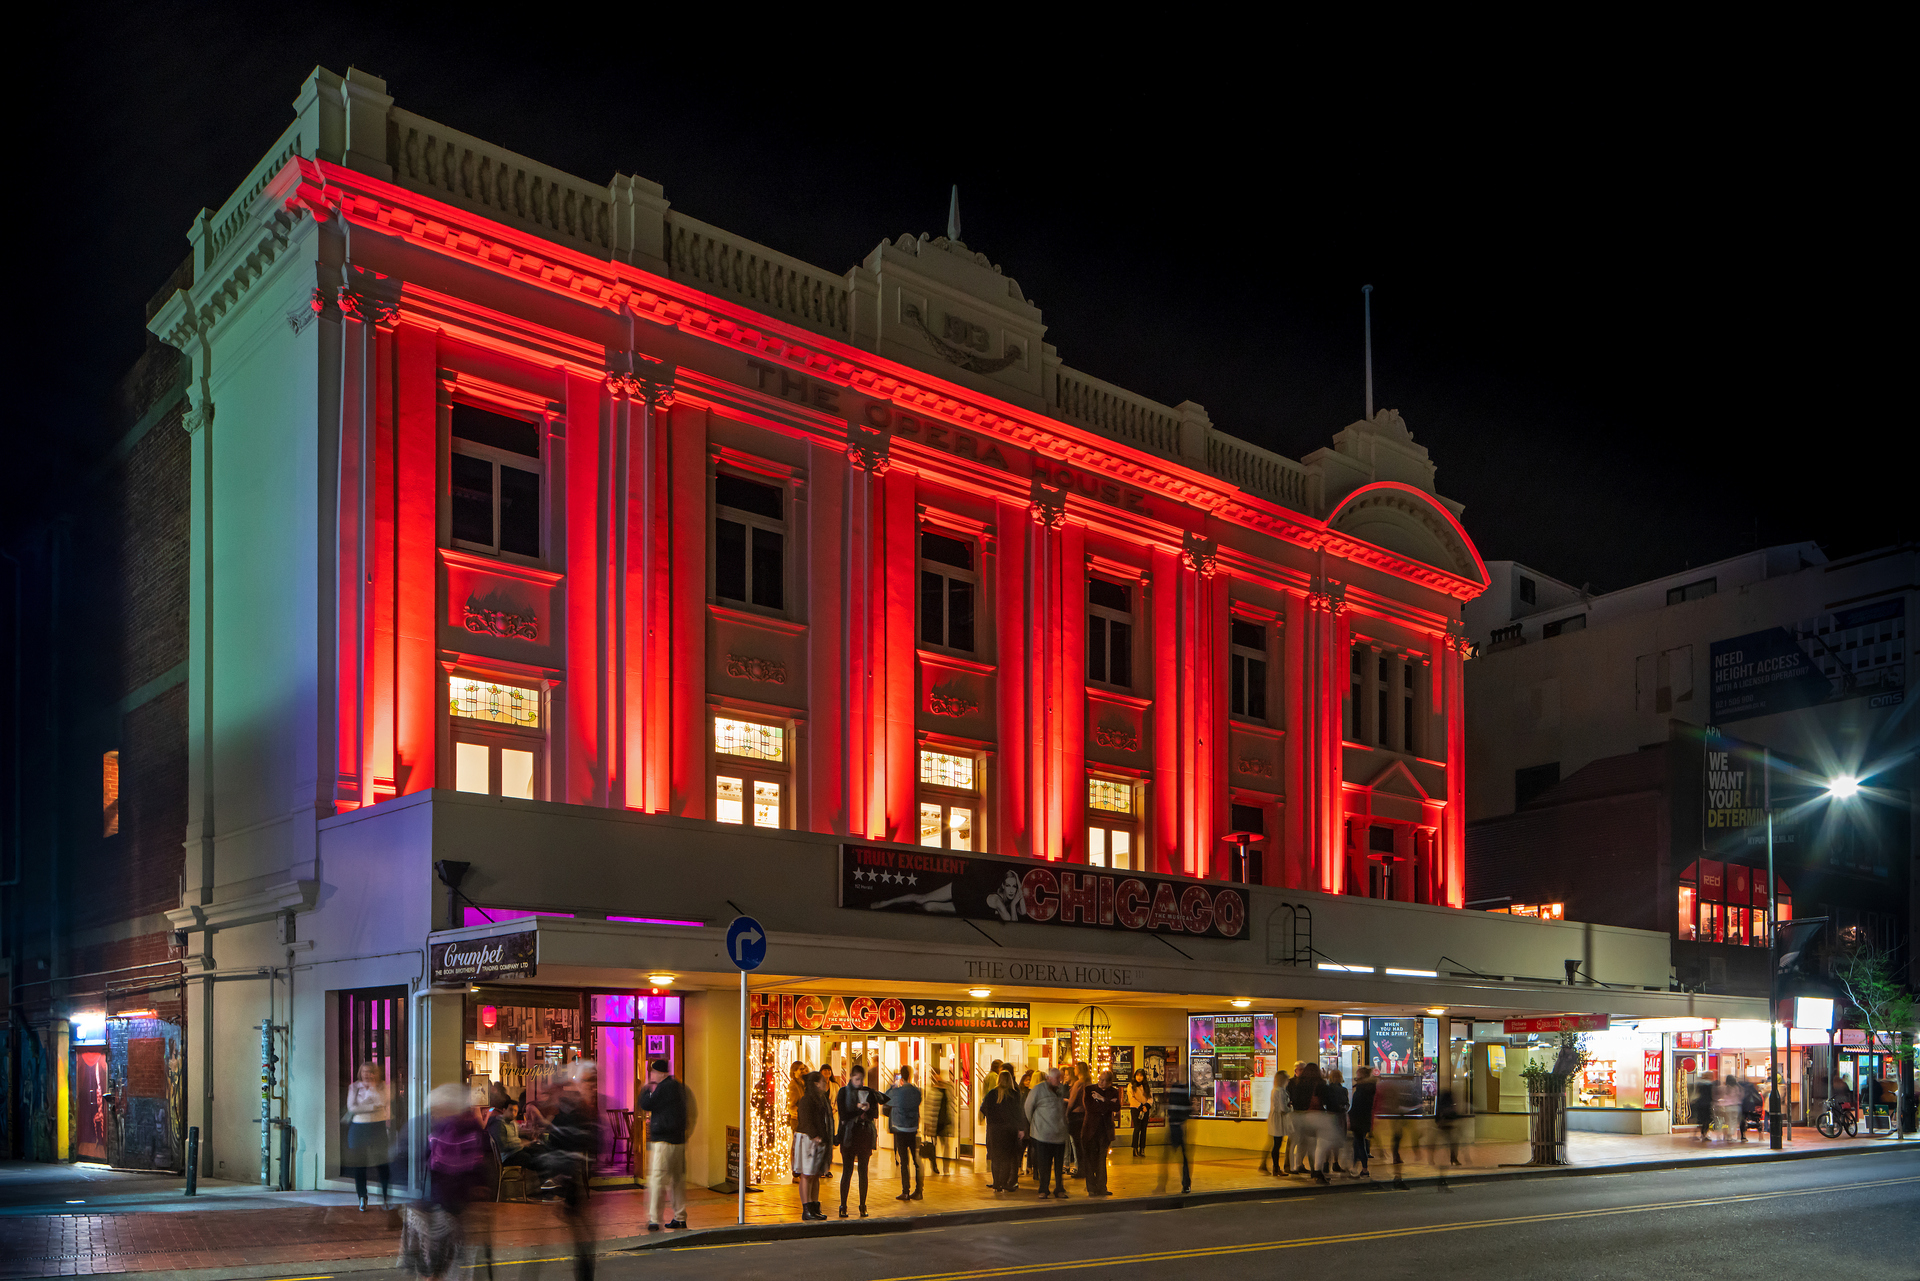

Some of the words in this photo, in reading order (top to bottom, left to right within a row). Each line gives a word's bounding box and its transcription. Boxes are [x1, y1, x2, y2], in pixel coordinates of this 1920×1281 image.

[746, 359, 840, 413] THE
[865, 400, 1009, 470] OPERA
[1715, 650, 1743, 668] NEED
[1715, 662, 1754, 683] HEIGHT
[1756, 652, 1800, 674] ACCESS
[1715, 683, 1732, 693] WITH
[1733, 682, 1738, 690] A
[1739, 675, 1770, 688] LICENSED
[1771, 665, 1810, 682] OPERATOR?
[1705, 725, 1720, 738] APN
[1708, 751, 1729, 771] WE
[1708, 771, 1744, 790] WANT
[1708, 790, 1742, 808] YOUR
[1703, 875, 1721, 887] RED
[1021, 868, 1245, 937] CHICAGO
[1167, 914, 1193, 922] MUSICAL
[444, 943, 504, 974] Crumpet
[482, 964, 498, 972] TRADING
[965, 960, 1004, 979] THE
[1009, 963, 1069, 982] OPERA
[1075, 967, 1133, 985] HOUSE
[750, 993, 905, 1032] HICAGO
[910, 1004, 925, 1016] 13
[936, 1005, 953, 1017] 23
[955, 1006, 1028, 1019] SEPTEMBER
[910, 1018, 1029, 1029] CHICAGOMUSICAL.CO.NZ
[500, 1061, 555, 1082] Crumpet
[1645, 1057, 1661, 1072] SALE
[1644, 1074, 1660, 1088] SALE
[1644, 1090, 1658, 1105] SALE
